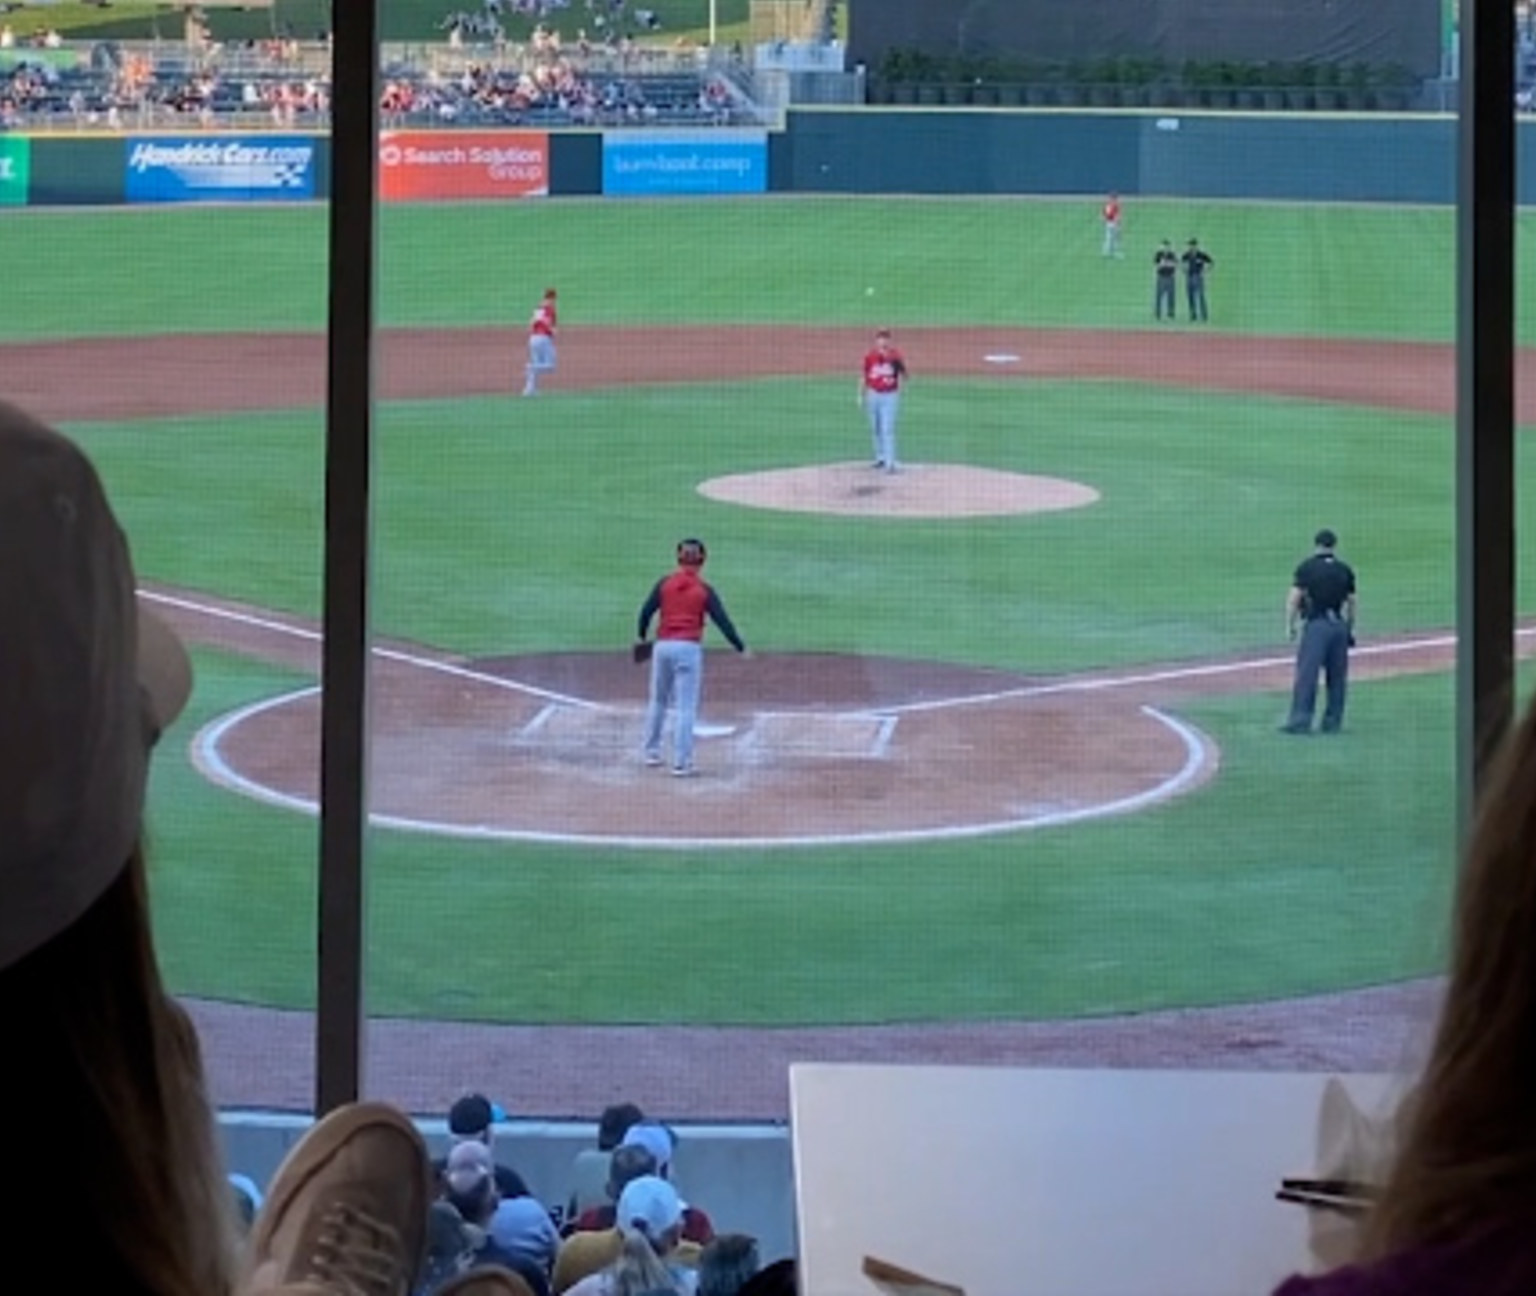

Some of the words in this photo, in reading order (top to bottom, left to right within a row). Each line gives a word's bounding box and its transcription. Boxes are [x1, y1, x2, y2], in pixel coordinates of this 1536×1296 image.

[403, 146, 466, 164] Search
[468, 145, 543, 165] Solution
[487, 163, 543, 181] Group
